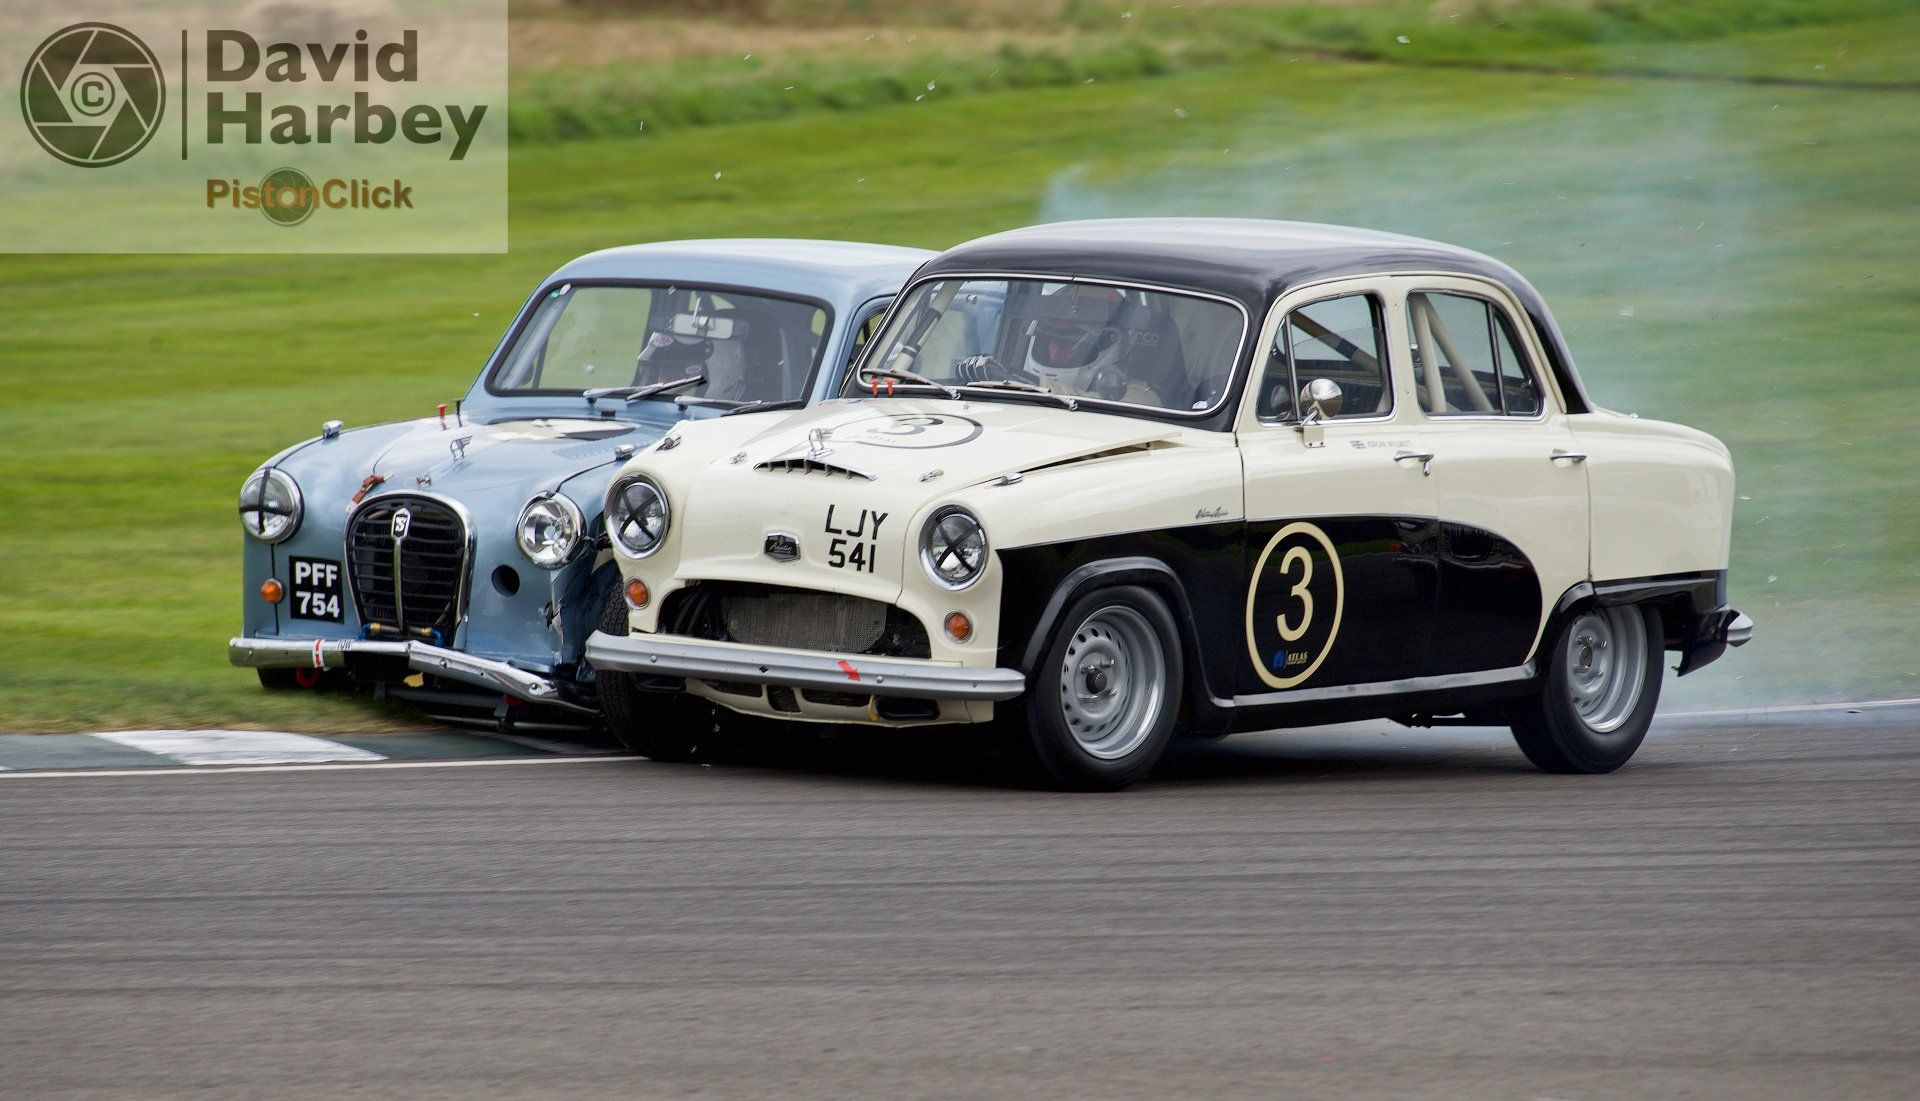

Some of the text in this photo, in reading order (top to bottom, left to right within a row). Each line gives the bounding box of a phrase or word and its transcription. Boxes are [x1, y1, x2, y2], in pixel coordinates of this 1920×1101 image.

[824, 504, 889, 540] LJY
[828, 538, 876, 573] 541
[294, 561, 338, 588] PFF
[296, 591, 340, 618] 754
[1276, 545, 1314, 642] 3
[1287, 651, 1308, 661] ATLAS
